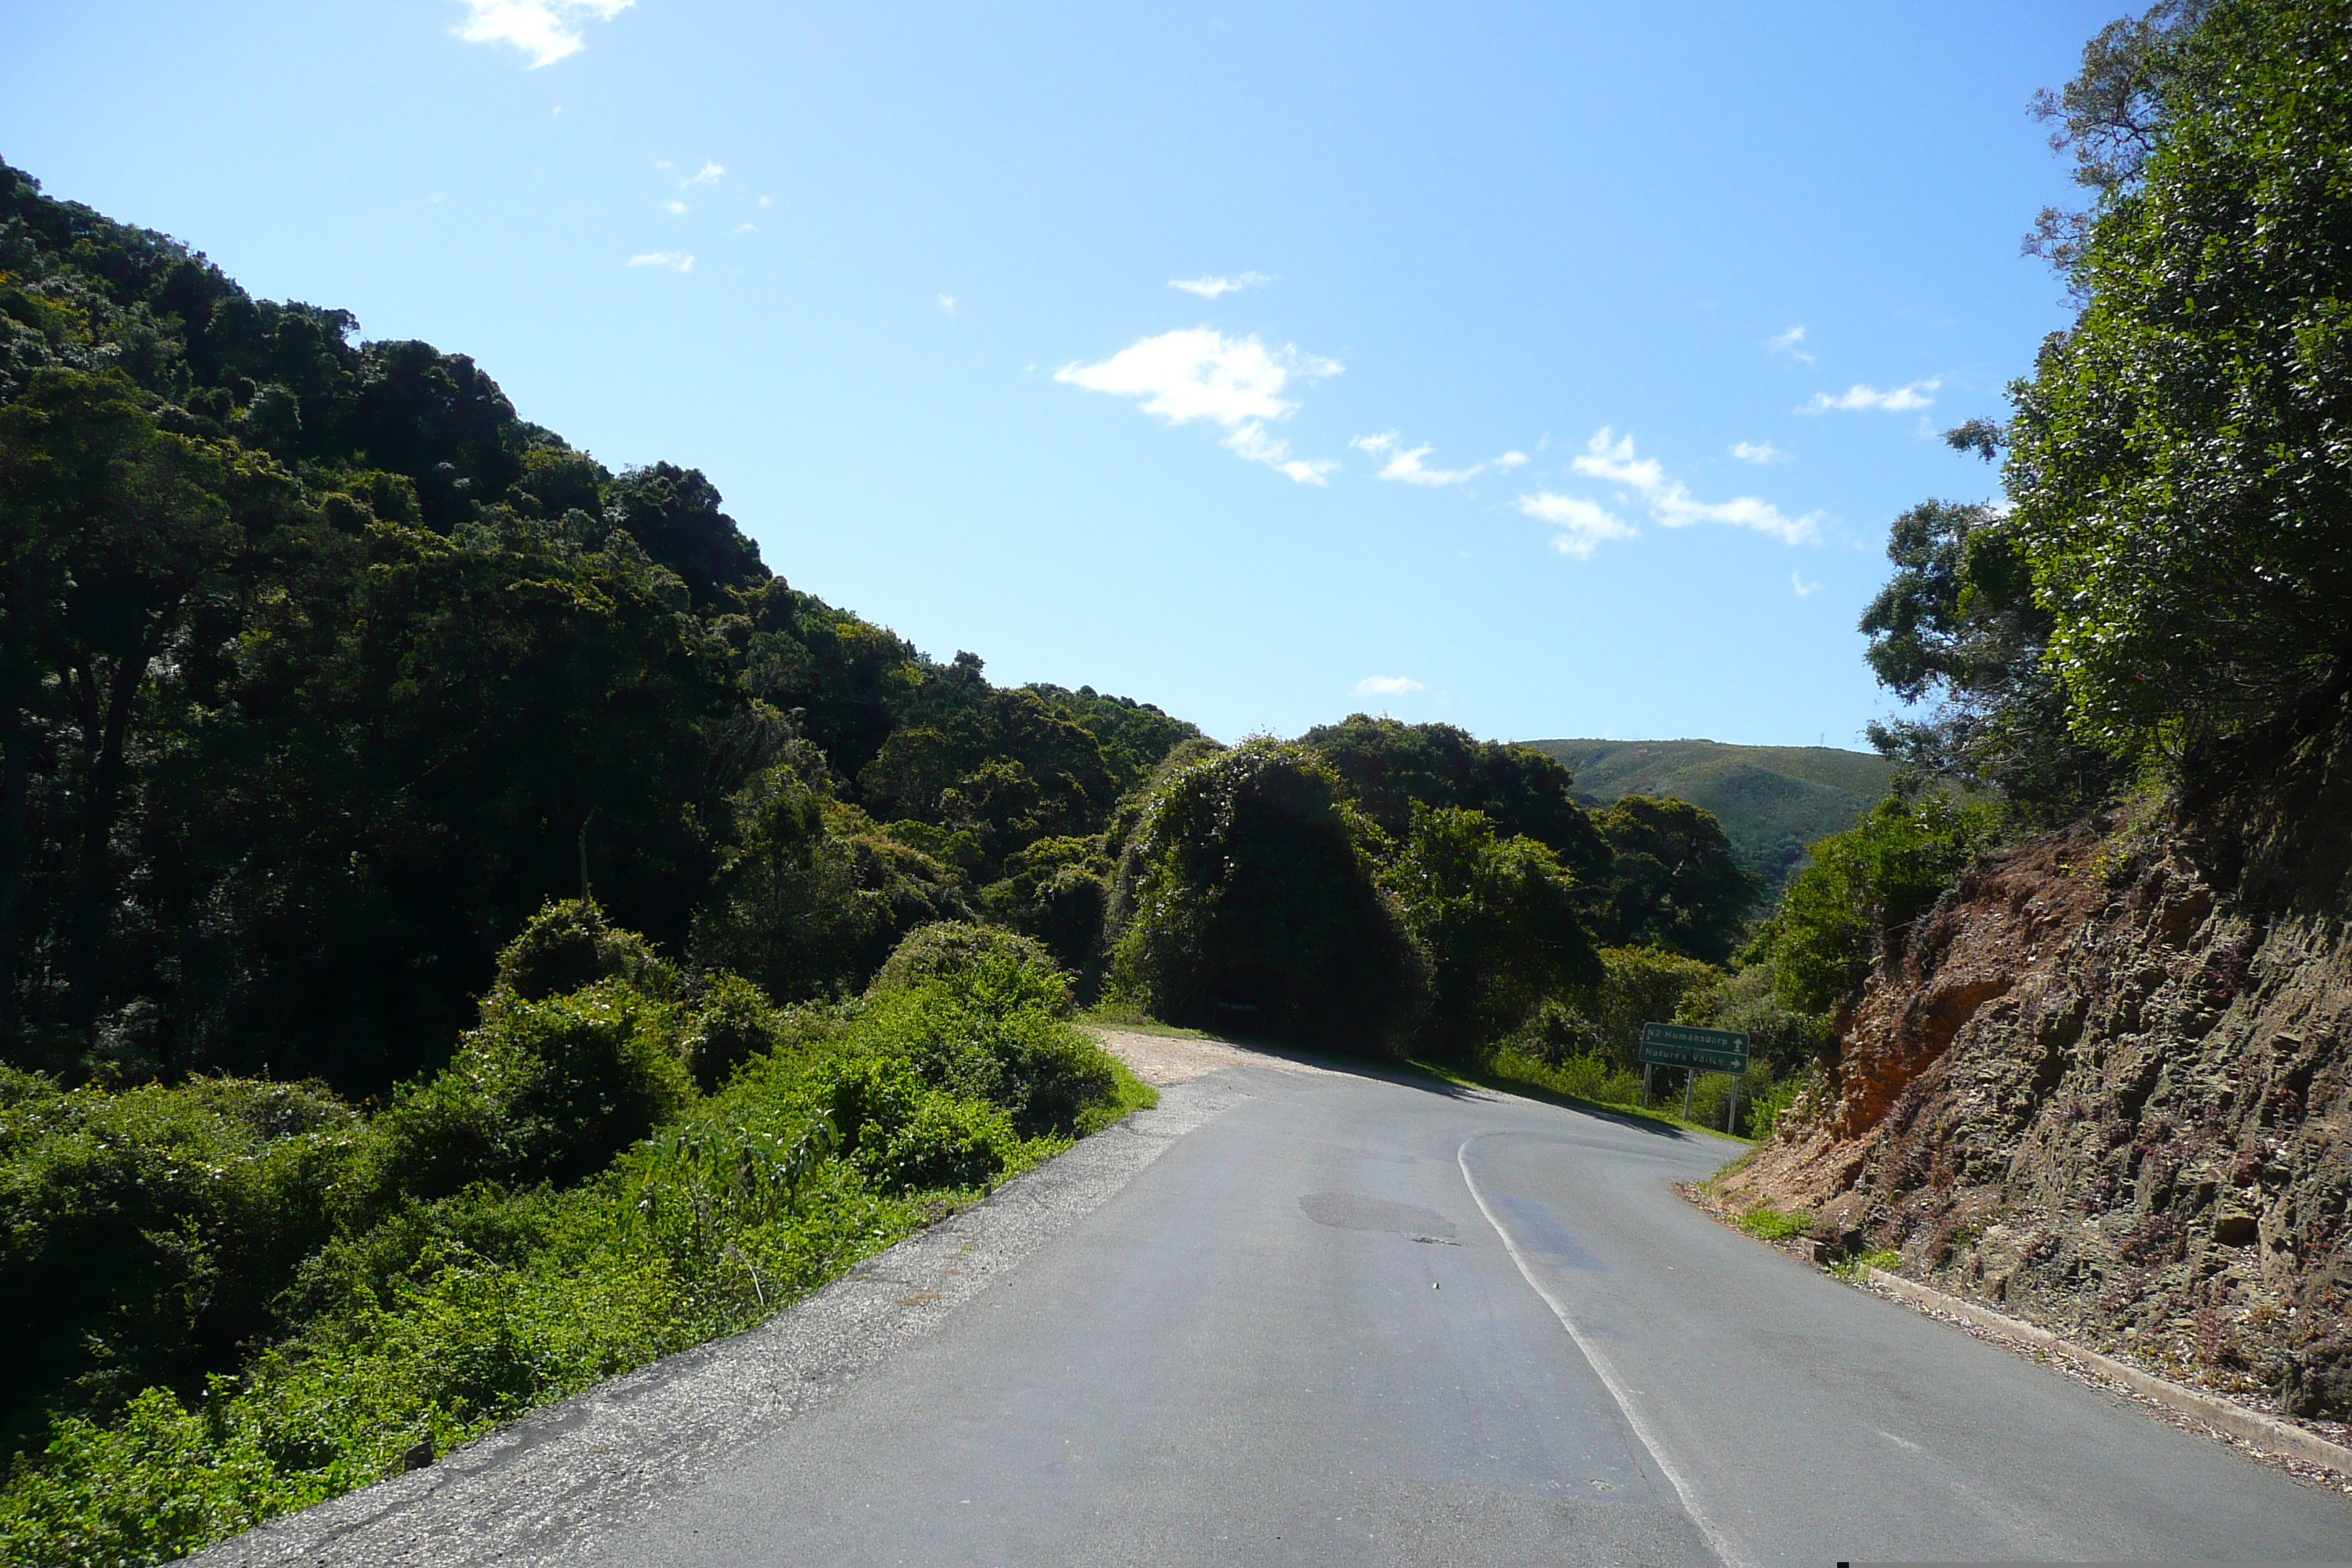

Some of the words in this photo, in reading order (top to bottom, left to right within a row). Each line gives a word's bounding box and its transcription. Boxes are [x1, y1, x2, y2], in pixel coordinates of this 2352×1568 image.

[1648, 1028, 1661, 1037] N2
[1665, 1031, 1727, 1046] Humansdorp
[1646, 1048, 1686, 1060] Natures
